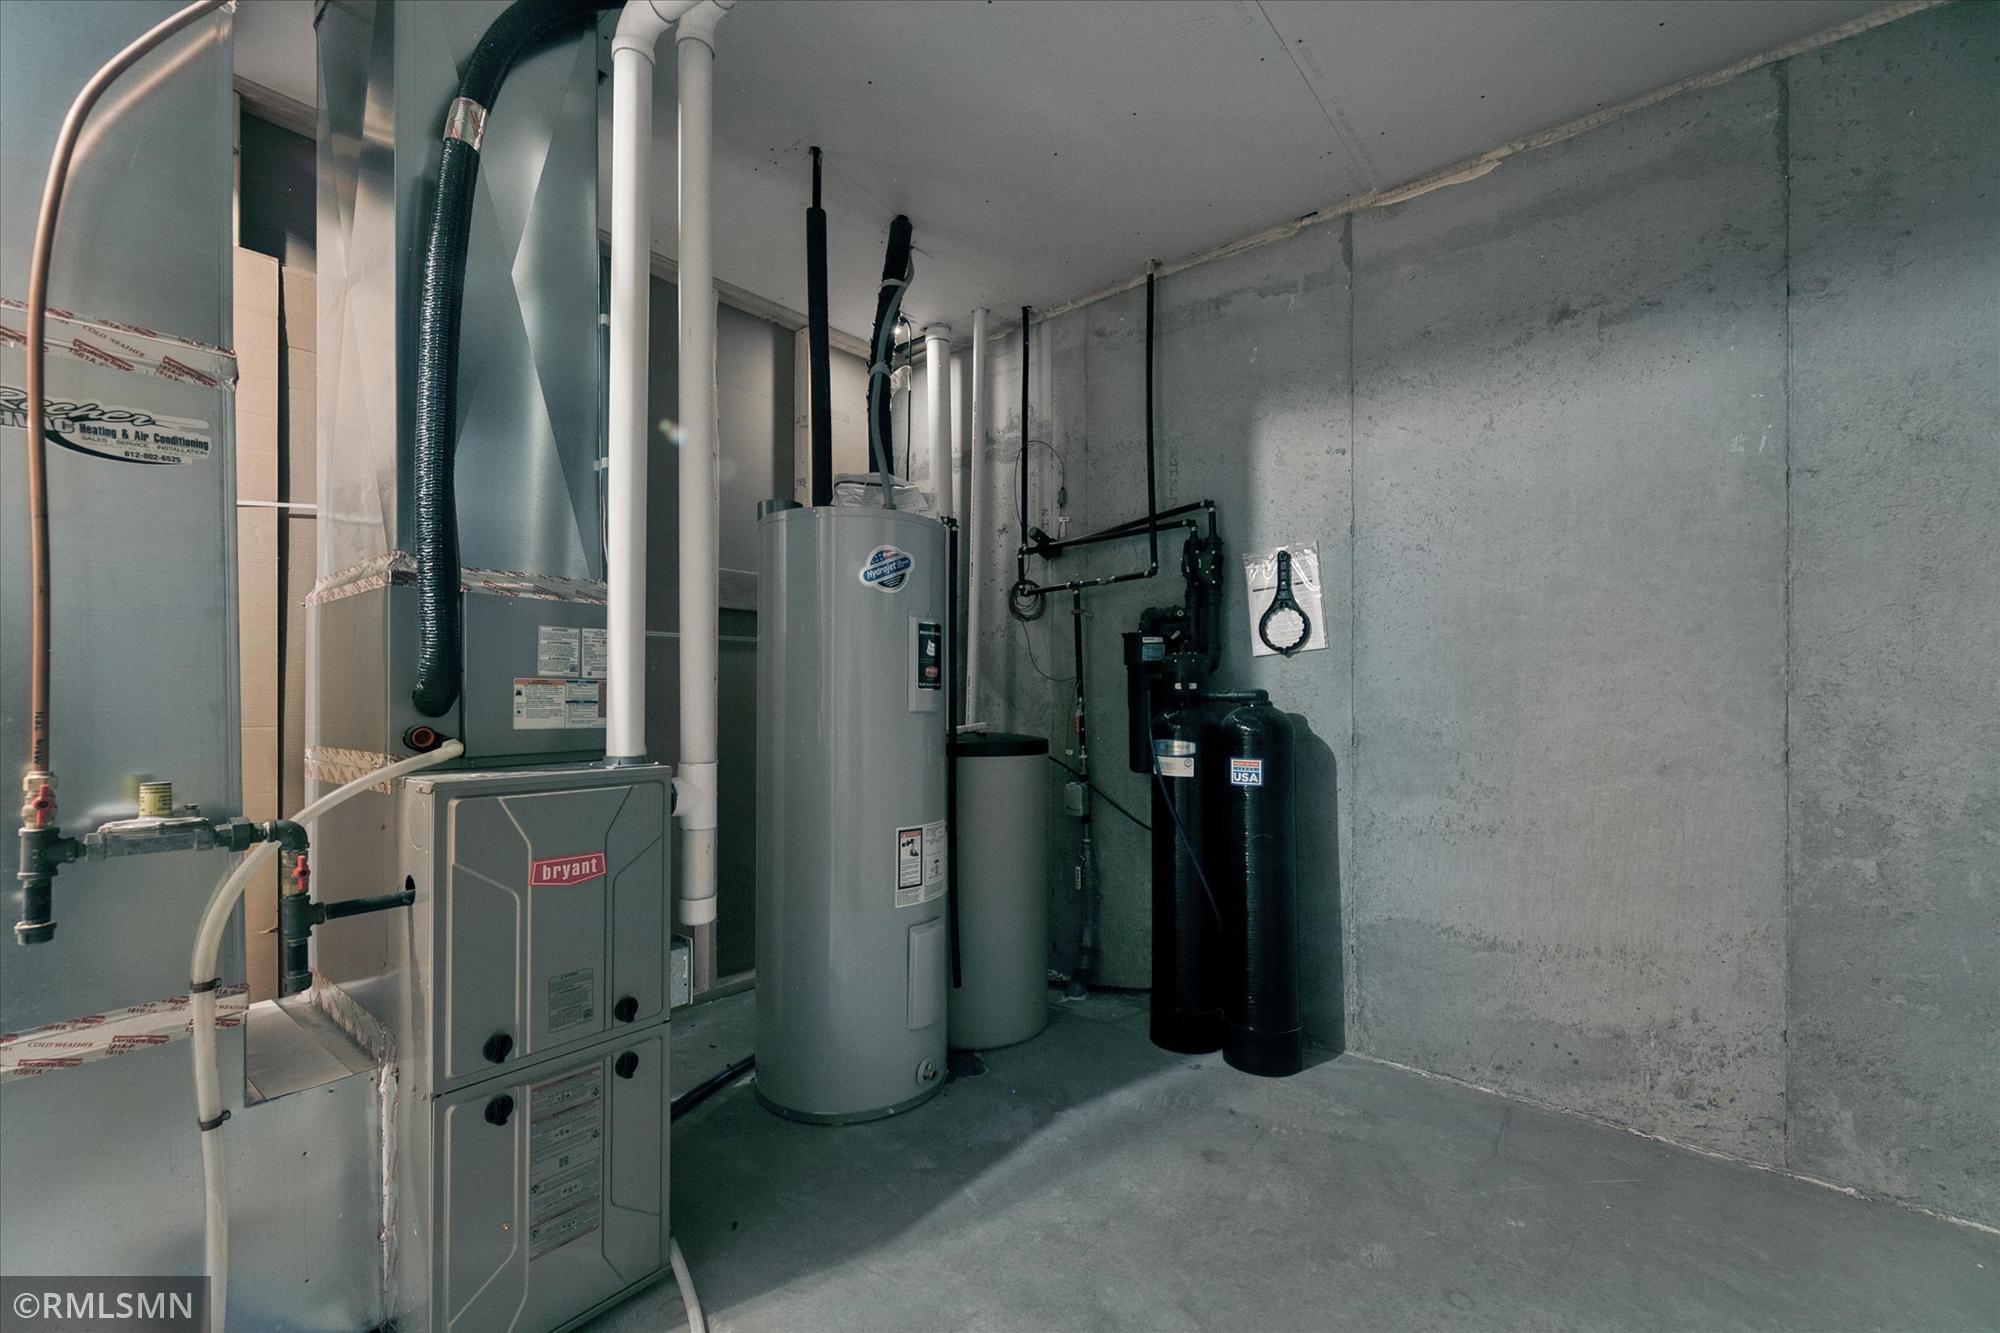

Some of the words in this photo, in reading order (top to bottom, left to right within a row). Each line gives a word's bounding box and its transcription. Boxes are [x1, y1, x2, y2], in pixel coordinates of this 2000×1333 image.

[79, 423, 117, 439] Heating
[121, 429, 129, 439] &
[134, 431, 149, 441] Air
[153, 433, 209, 450] Conditioning
[866, 561, 897, 580] Hydrojet
[1233, 771, 1259, 782] USA
[542, 858, 598, 880] bryant
